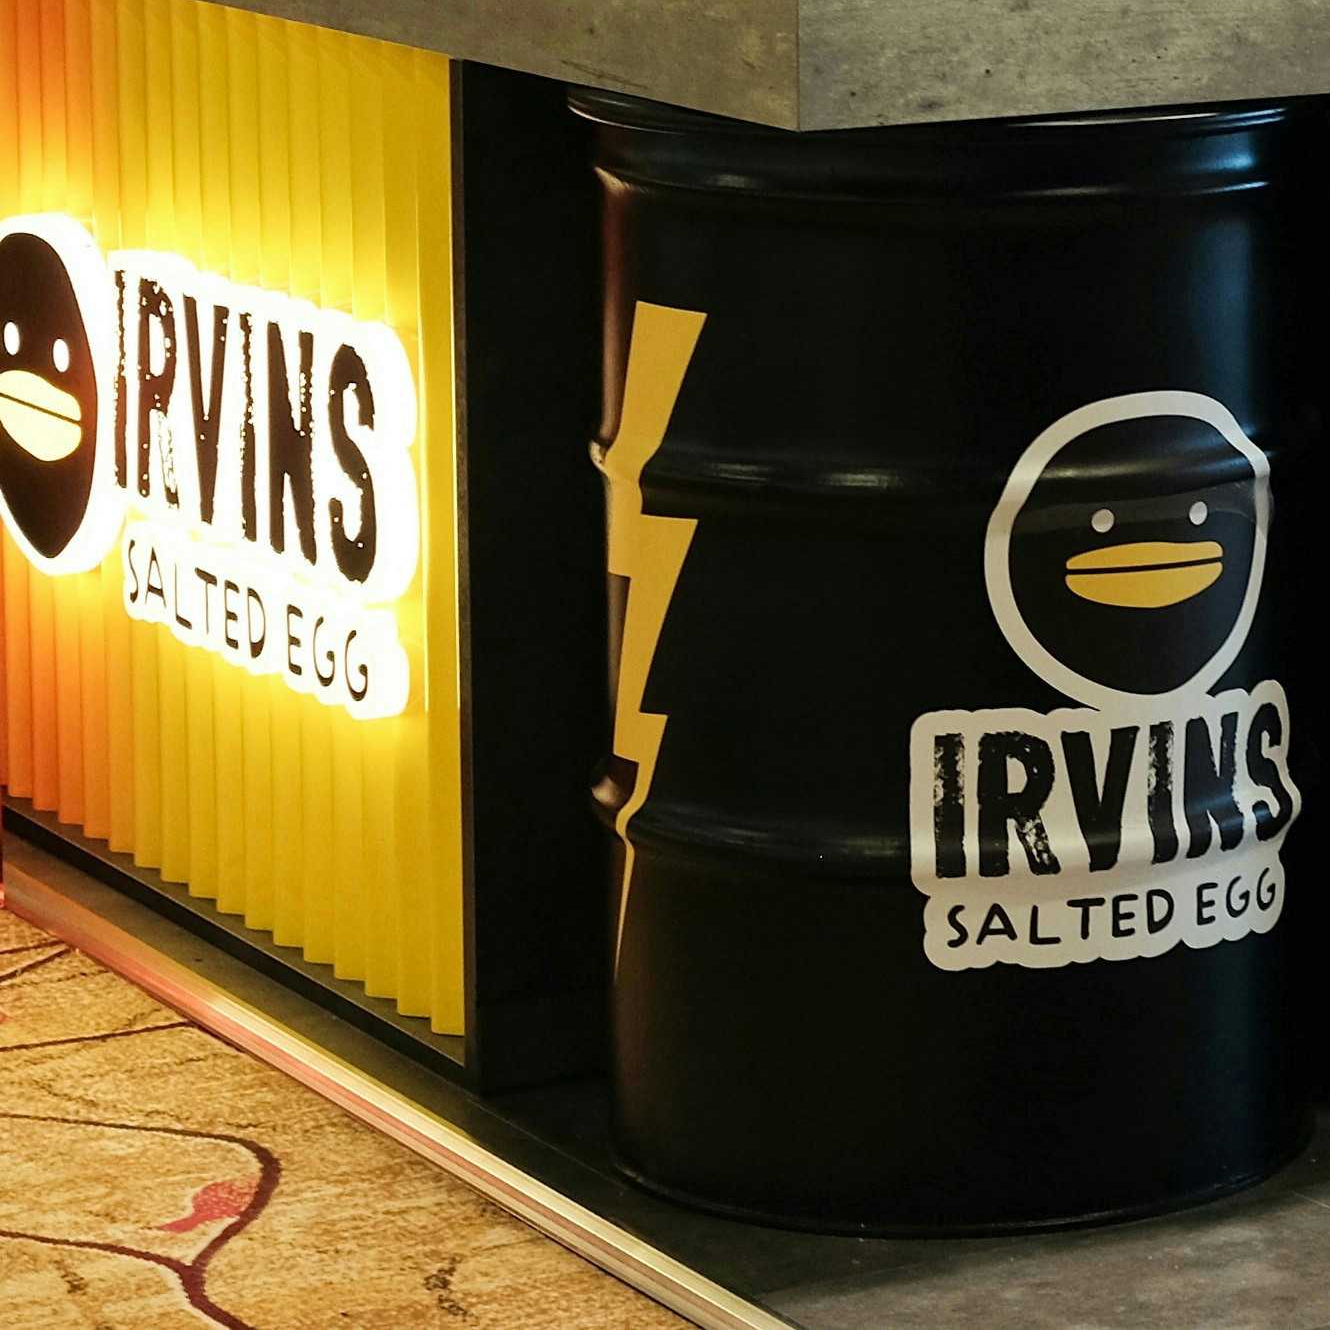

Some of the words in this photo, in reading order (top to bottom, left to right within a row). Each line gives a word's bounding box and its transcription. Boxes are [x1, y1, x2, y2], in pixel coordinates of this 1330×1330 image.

[113, 269, 378, 585] IRVINS
[128, 539, 267, 660] SALTED
[286, 604, 369, 702] EGG
[933, 702, 1294, 879] IRVINS
[947, 888, 1175, 949] SALTED
[1196, 868, 1277, 926] EGG
